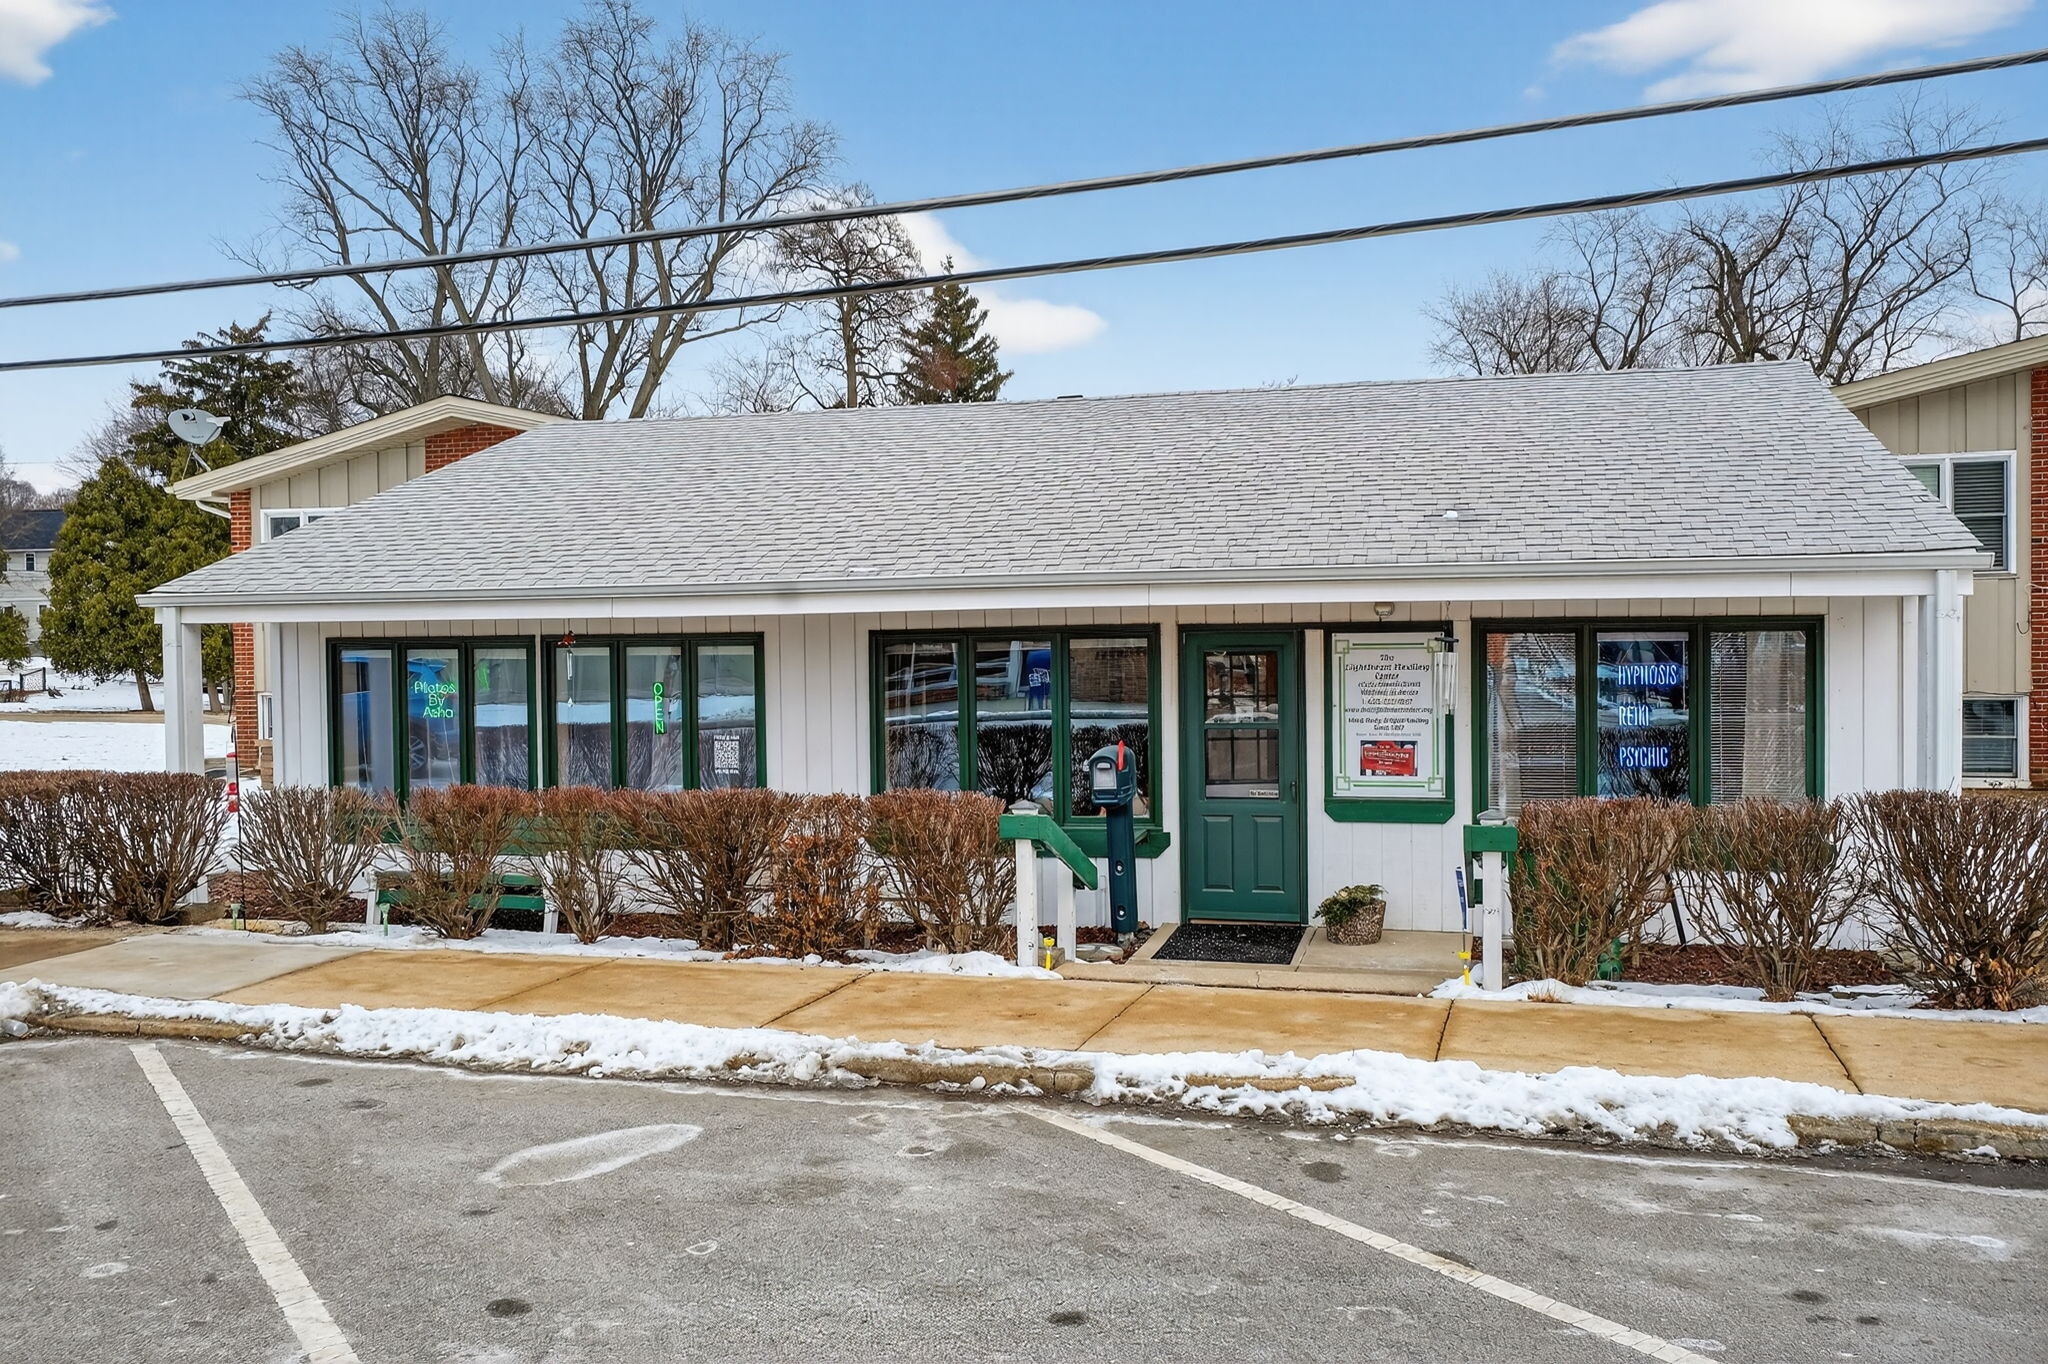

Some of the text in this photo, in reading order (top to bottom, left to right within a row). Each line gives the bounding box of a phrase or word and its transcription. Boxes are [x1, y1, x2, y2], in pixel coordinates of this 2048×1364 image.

[1618, 665, 1677, 685] HYPNOSIS
[654, 682, 664, 734] OPEN
[1619, 706, 1649, 726] REIKI
[1619, 747, 1668, 767] PSYCHIC
